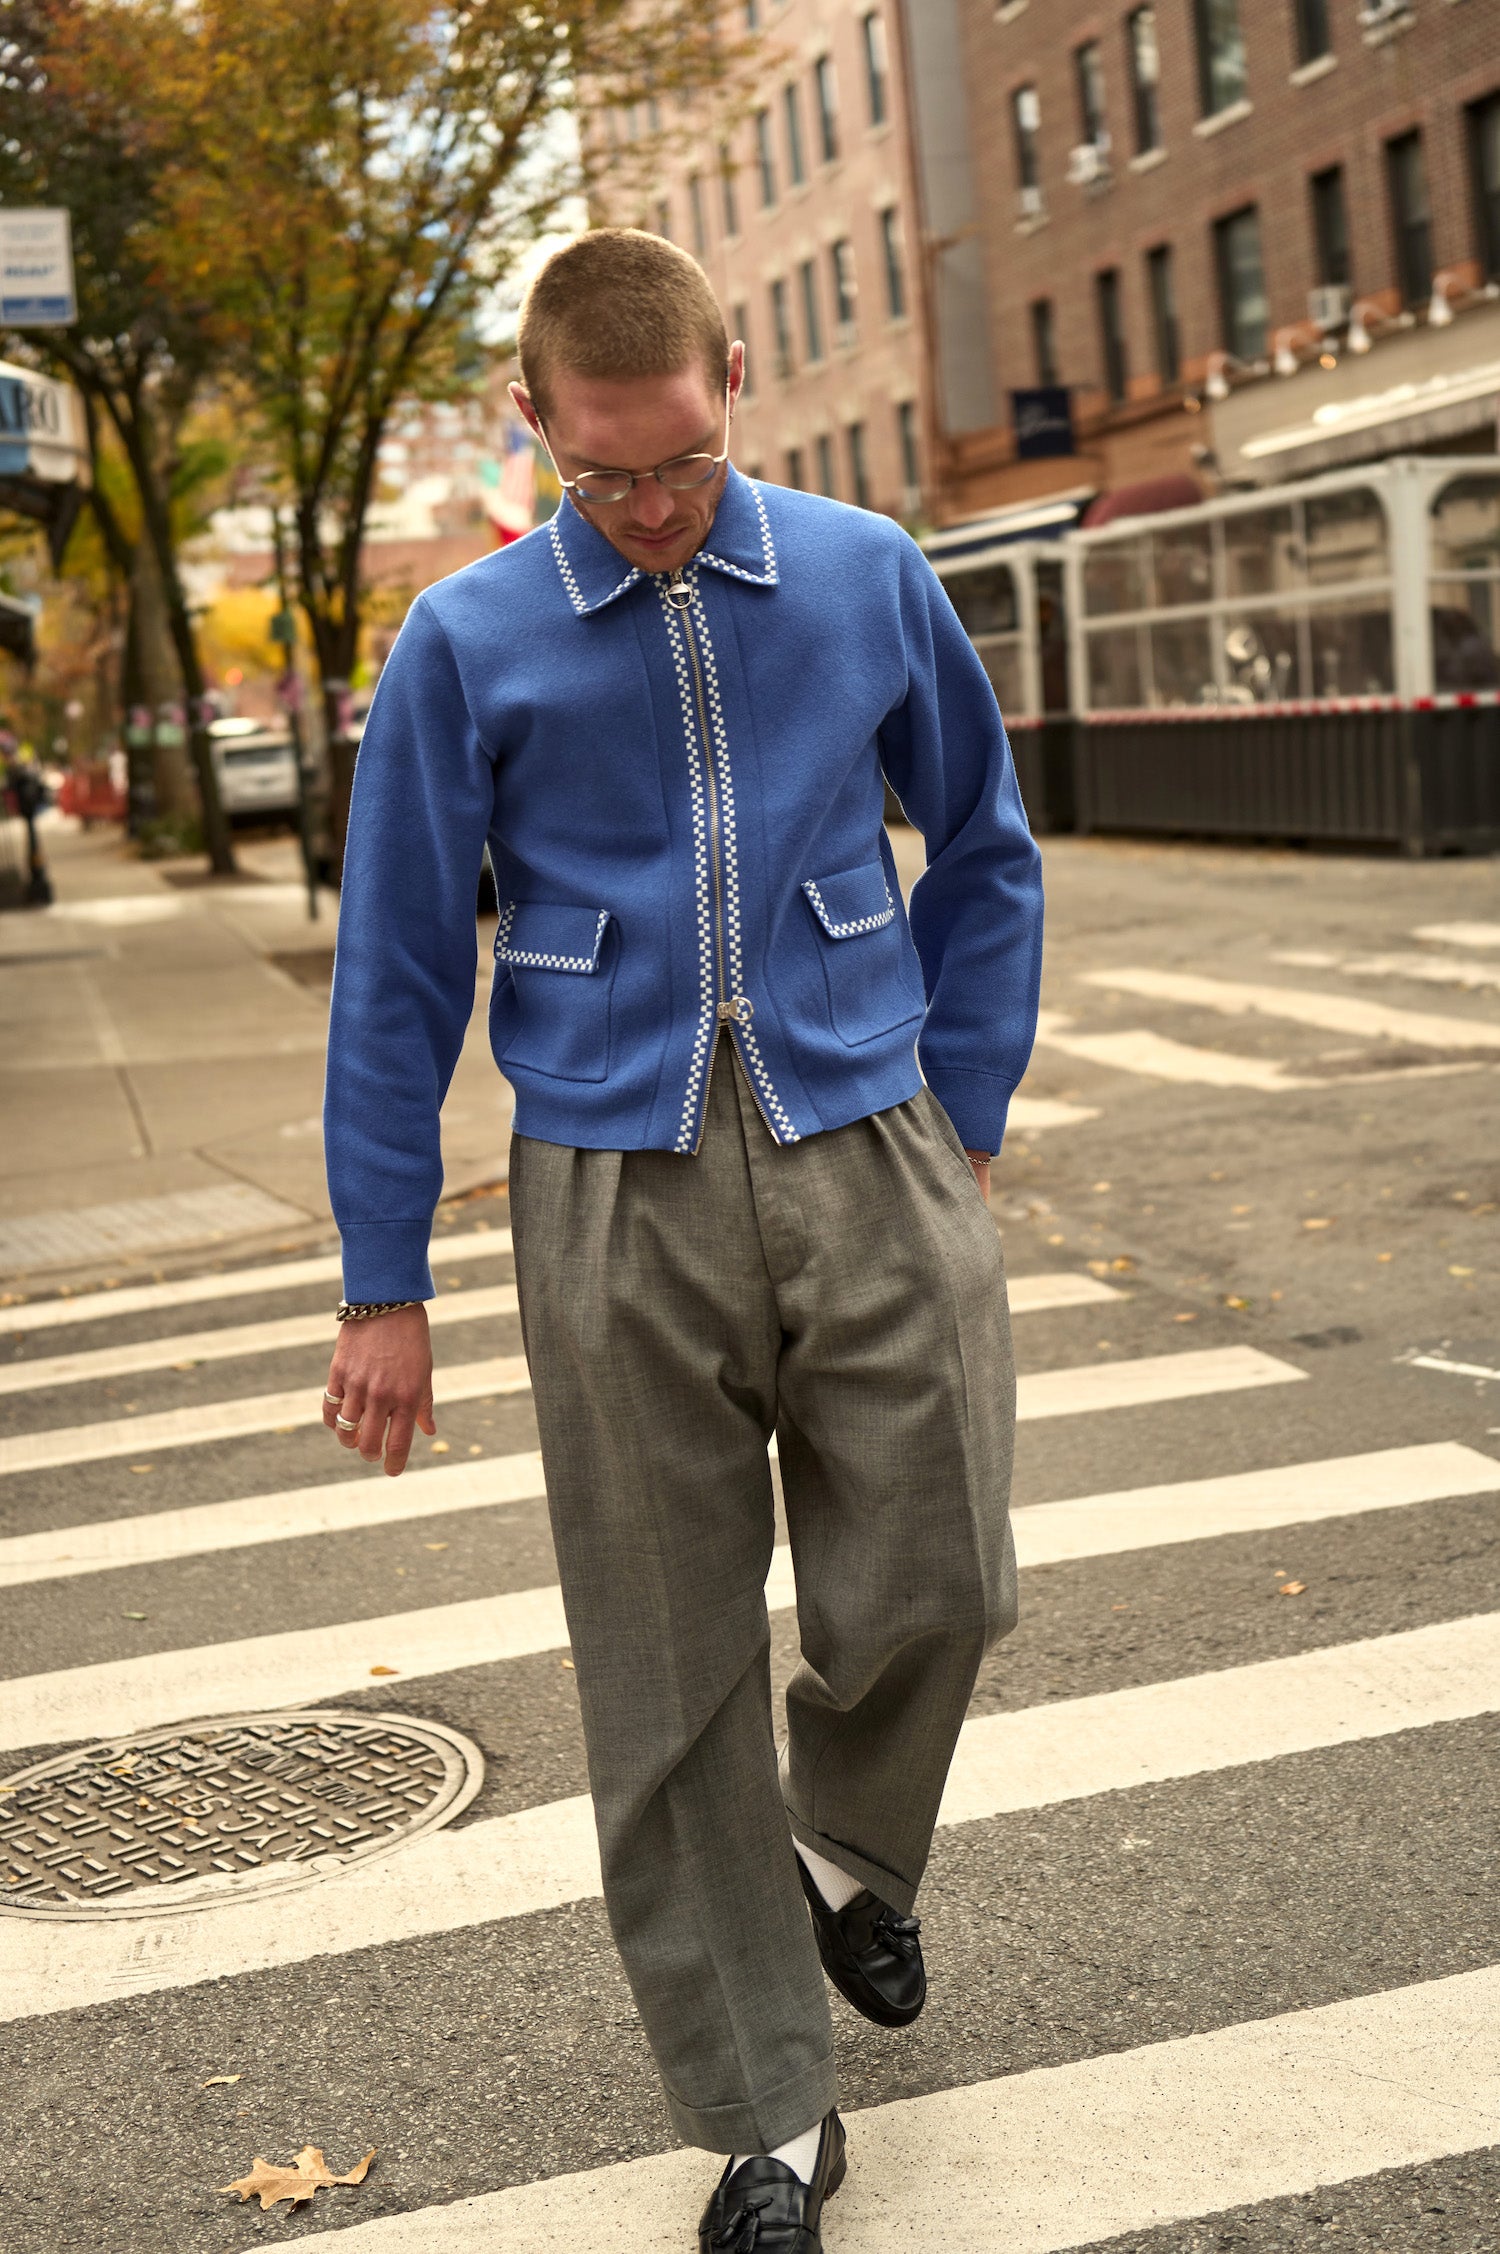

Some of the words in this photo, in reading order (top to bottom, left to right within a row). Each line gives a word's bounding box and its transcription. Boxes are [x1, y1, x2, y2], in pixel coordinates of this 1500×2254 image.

[103, 1758, 233, 1817] SEWER
[297, 1774, 376, 1810] MADE
[217, 1808, 328, 1862] N.Y.C.
